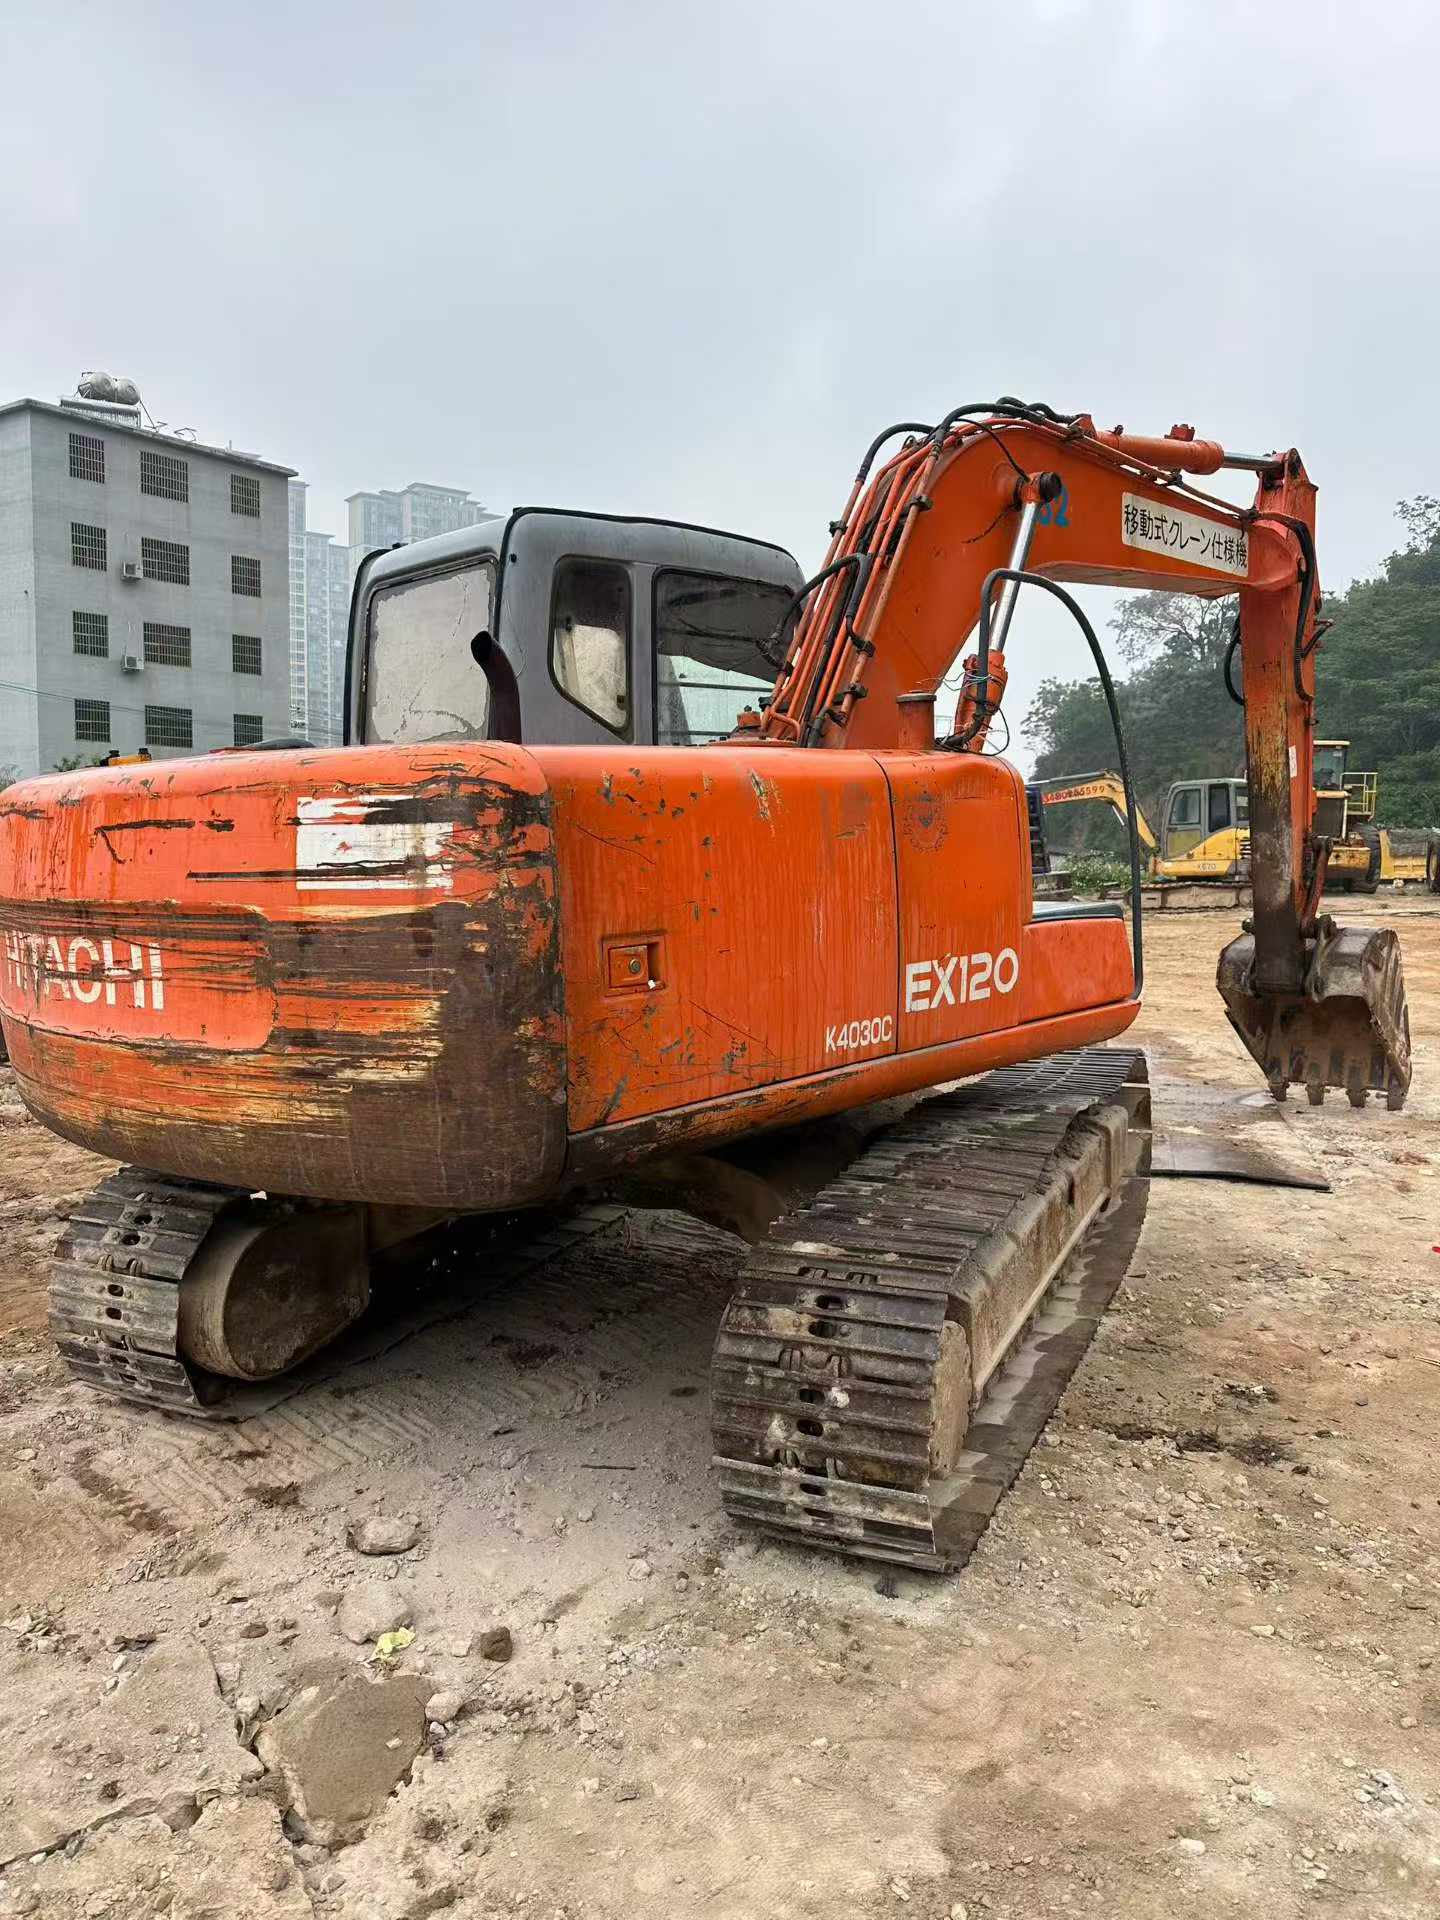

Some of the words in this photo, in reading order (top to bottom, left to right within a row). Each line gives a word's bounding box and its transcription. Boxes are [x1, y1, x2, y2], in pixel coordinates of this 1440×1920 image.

[1124, 503, 1248, 569] 移動式クレーン仕様機
[4, 929, 164, 1009] HITACHI
[904, 946, 1020, 1013] EX120
[825, 1014, 893, 1053] K4030C
